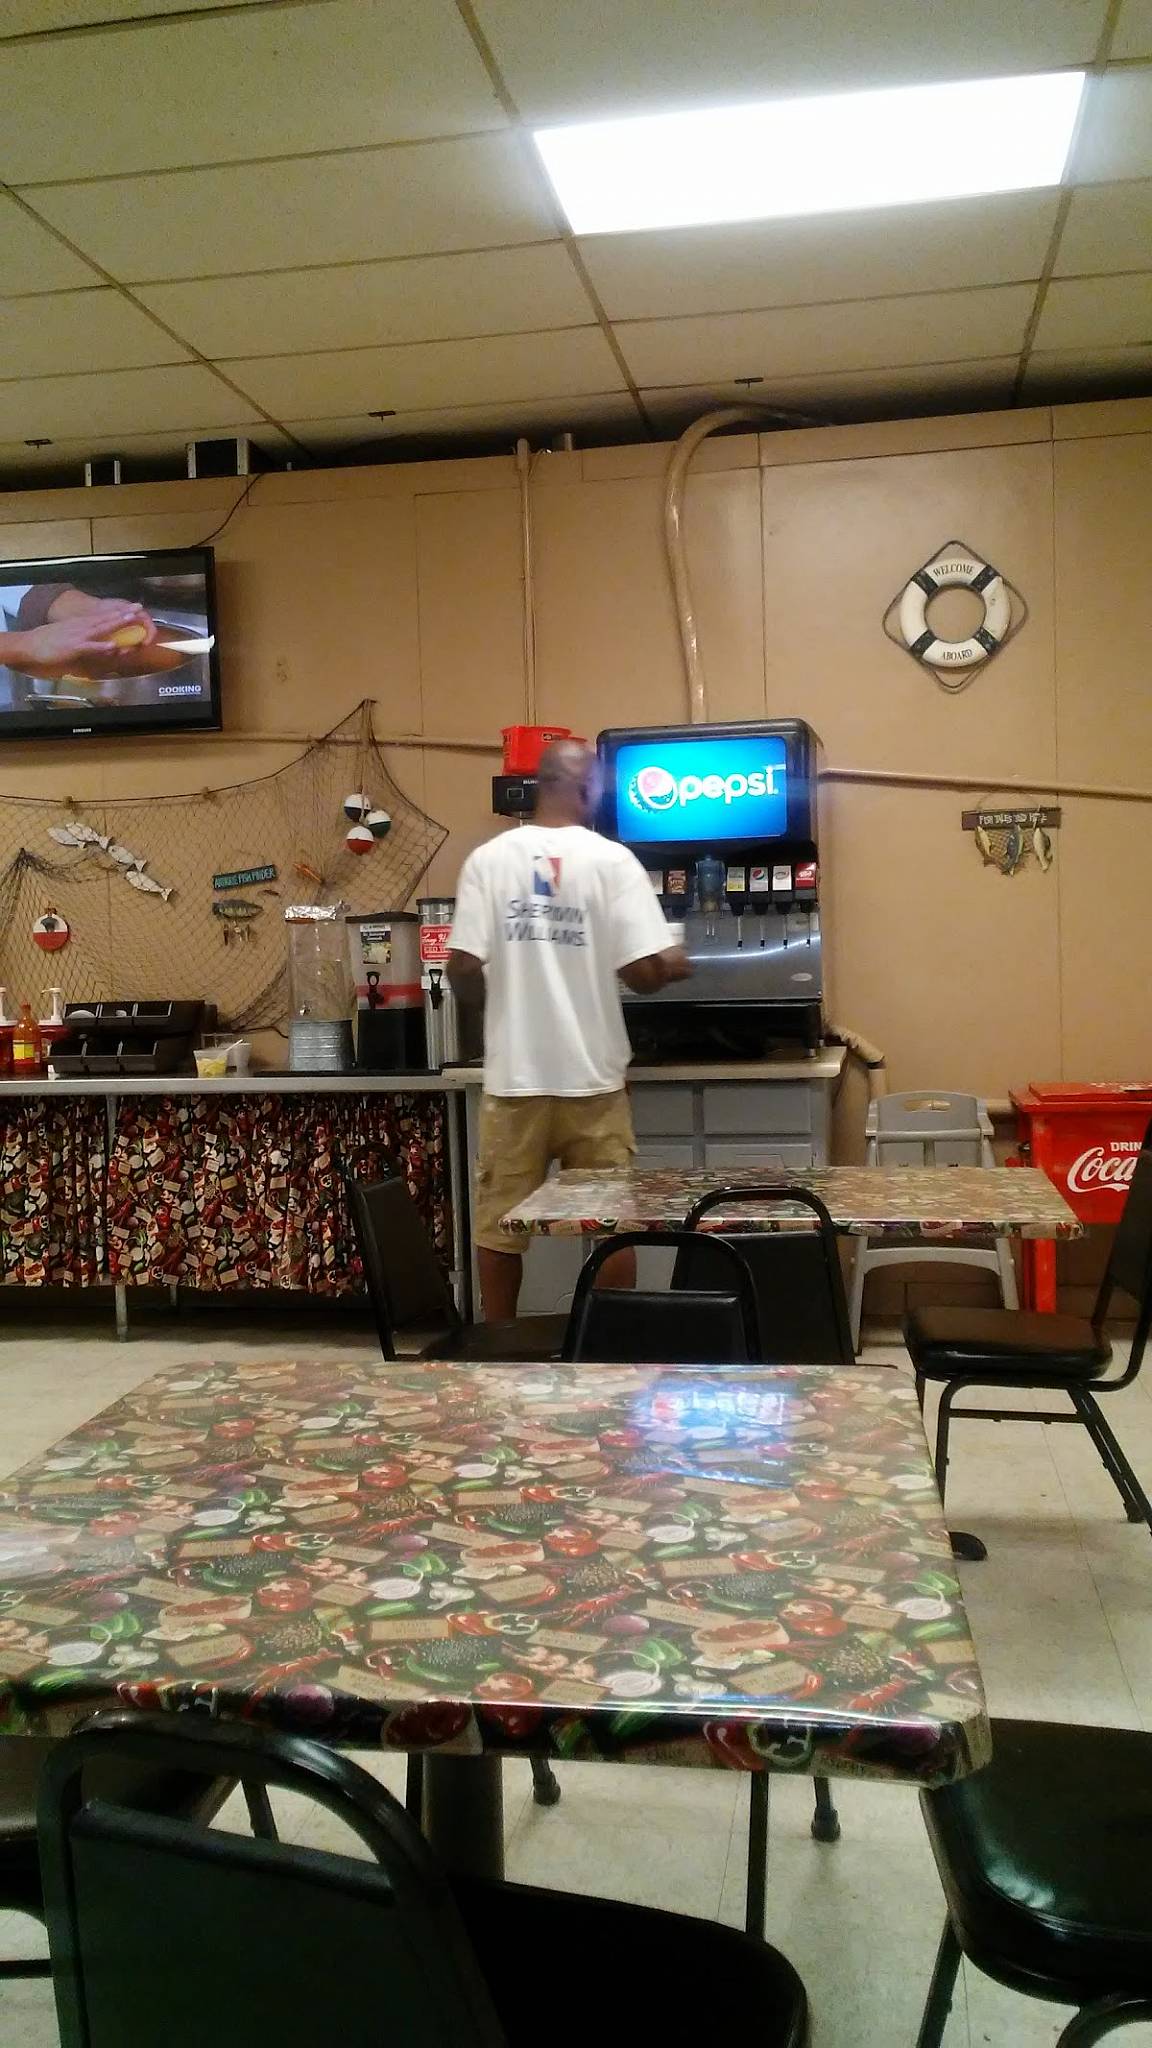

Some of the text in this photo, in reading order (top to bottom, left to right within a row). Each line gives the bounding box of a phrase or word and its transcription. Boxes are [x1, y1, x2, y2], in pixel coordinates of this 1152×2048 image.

[933, 563, 974, 577] WELCOME
[943, 648, 973, 661] ABOARD
[158, 684, 202, 695] COOKING
[1110, 1141, 1143, 1152] DRIN
